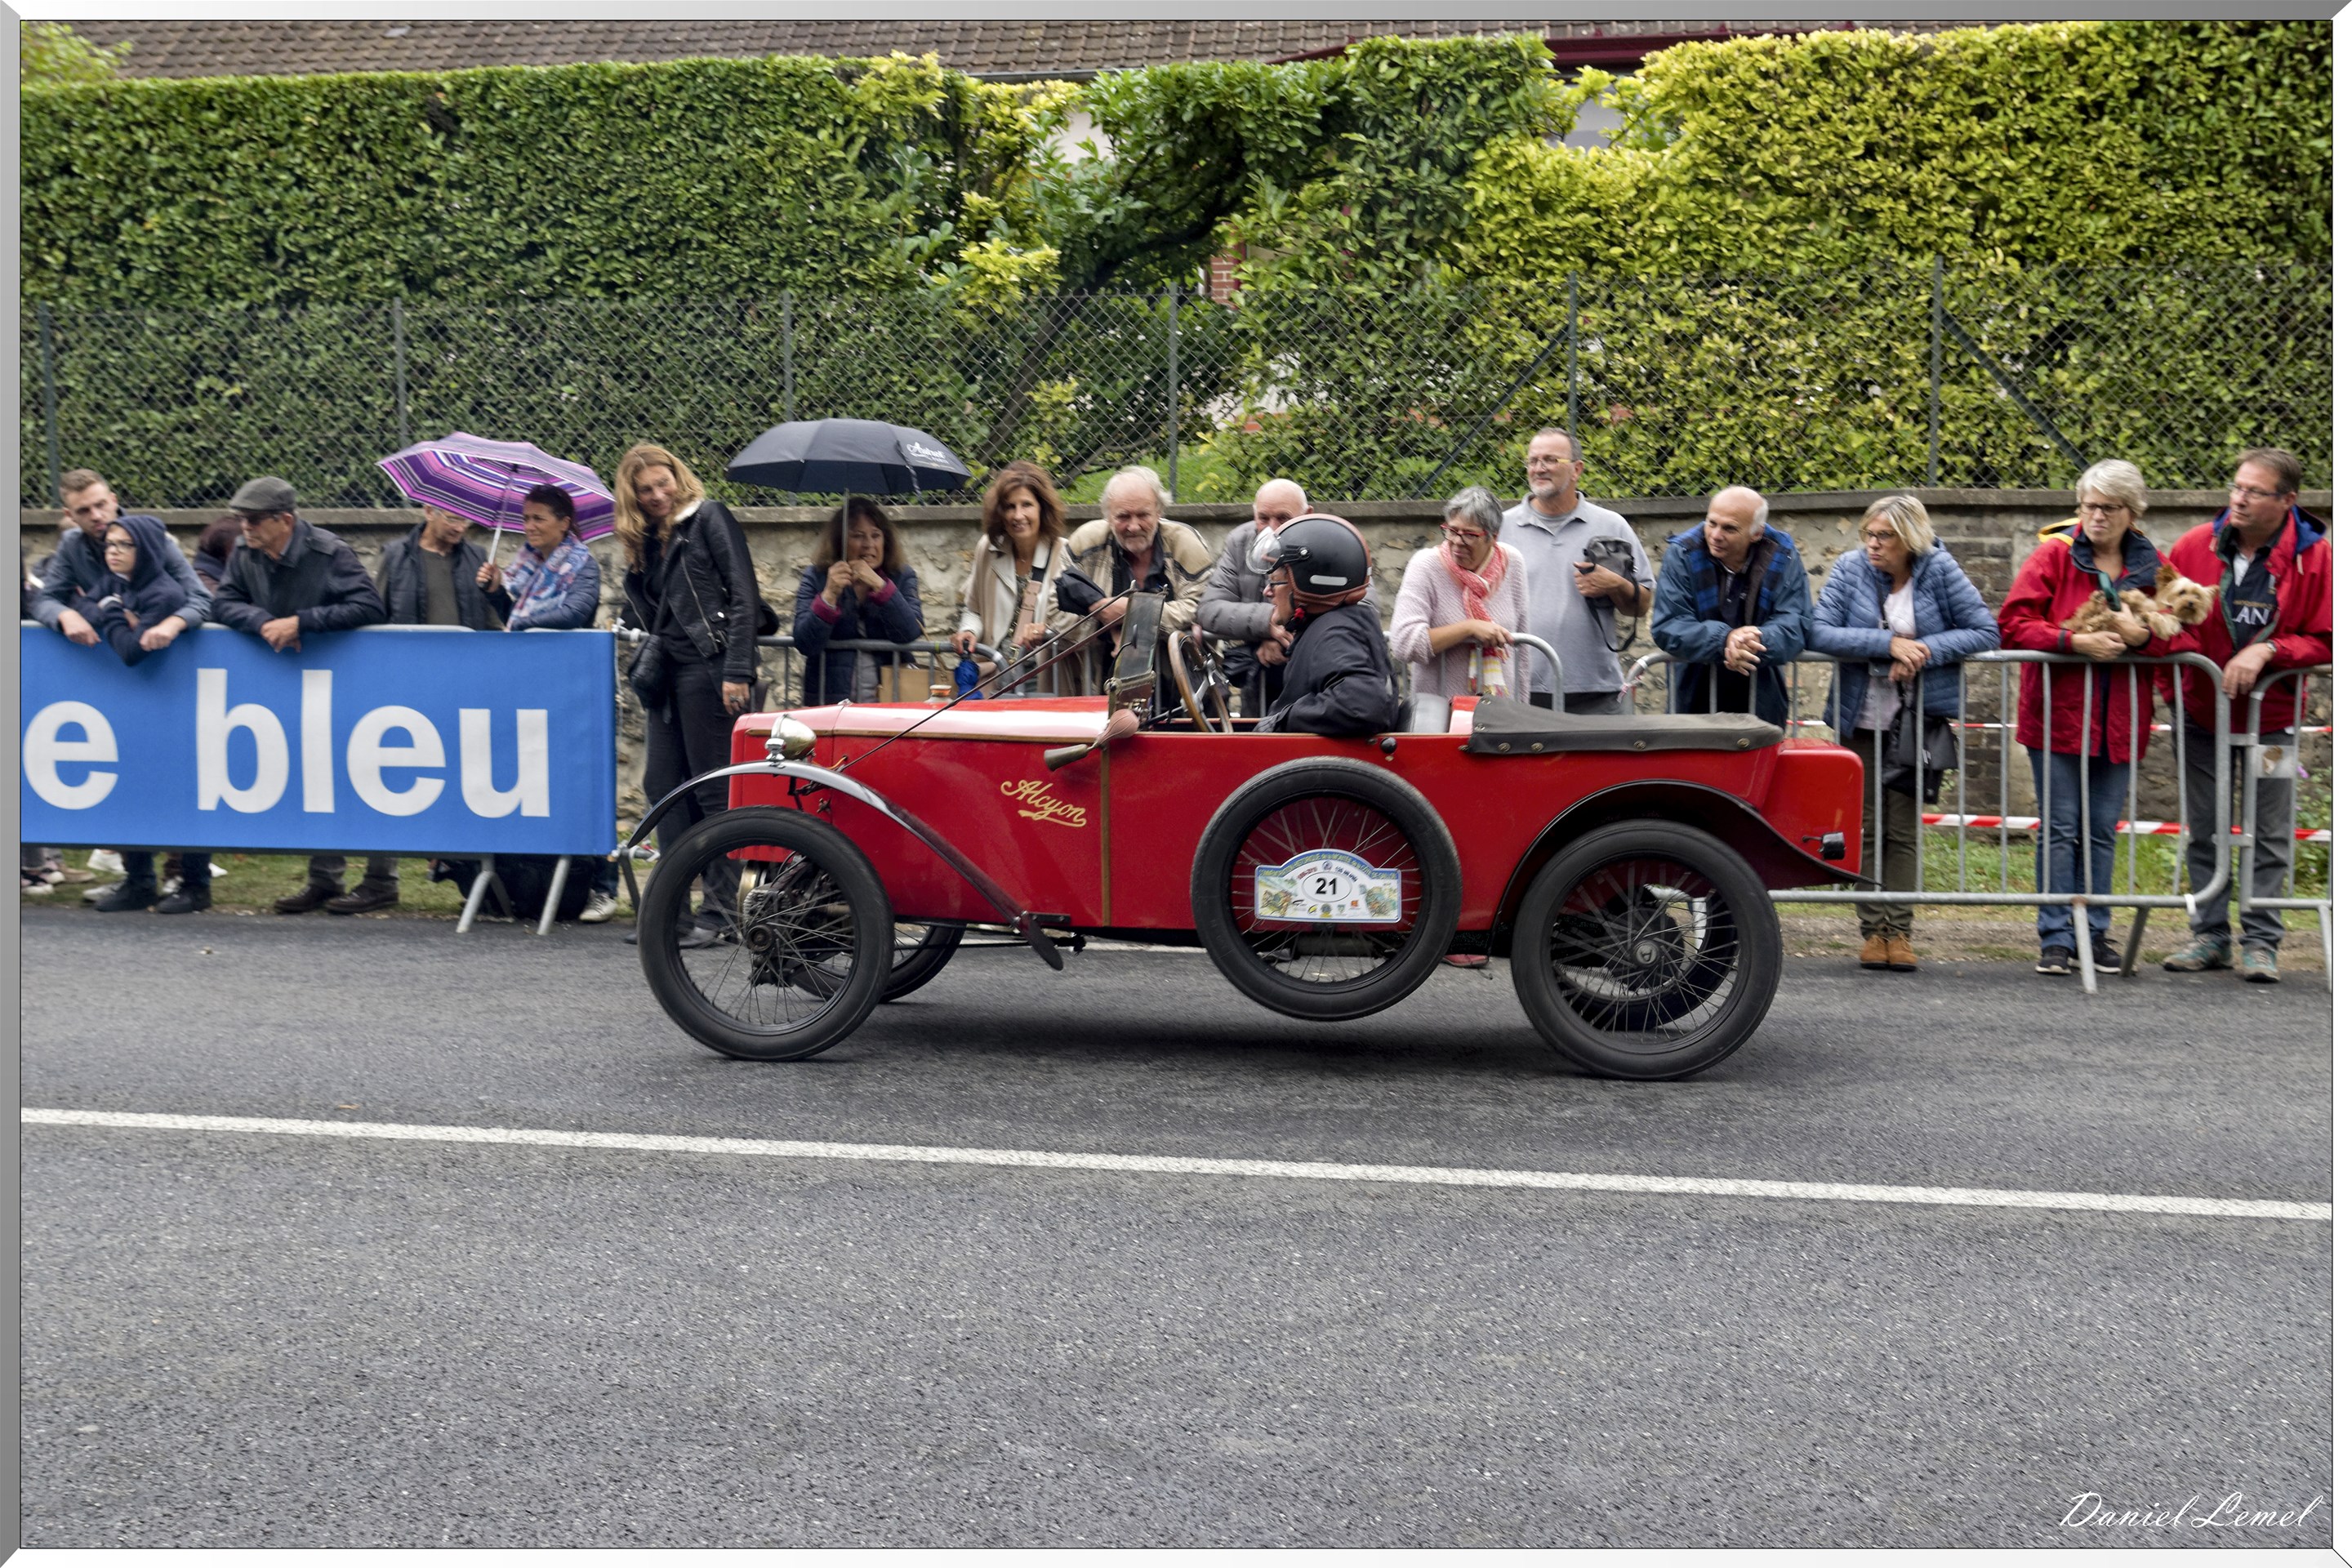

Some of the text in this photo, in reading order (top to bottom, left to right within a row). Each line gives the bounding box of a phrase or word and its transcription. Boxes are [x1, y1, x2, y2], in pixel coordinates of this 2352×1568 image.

[2232, 605, 2270, 625] AN
[23, 667, 551, 817] e bleu
[1000, 779, 1087, 828] Alcyon
[1316, 878, 1338, 895] 21
